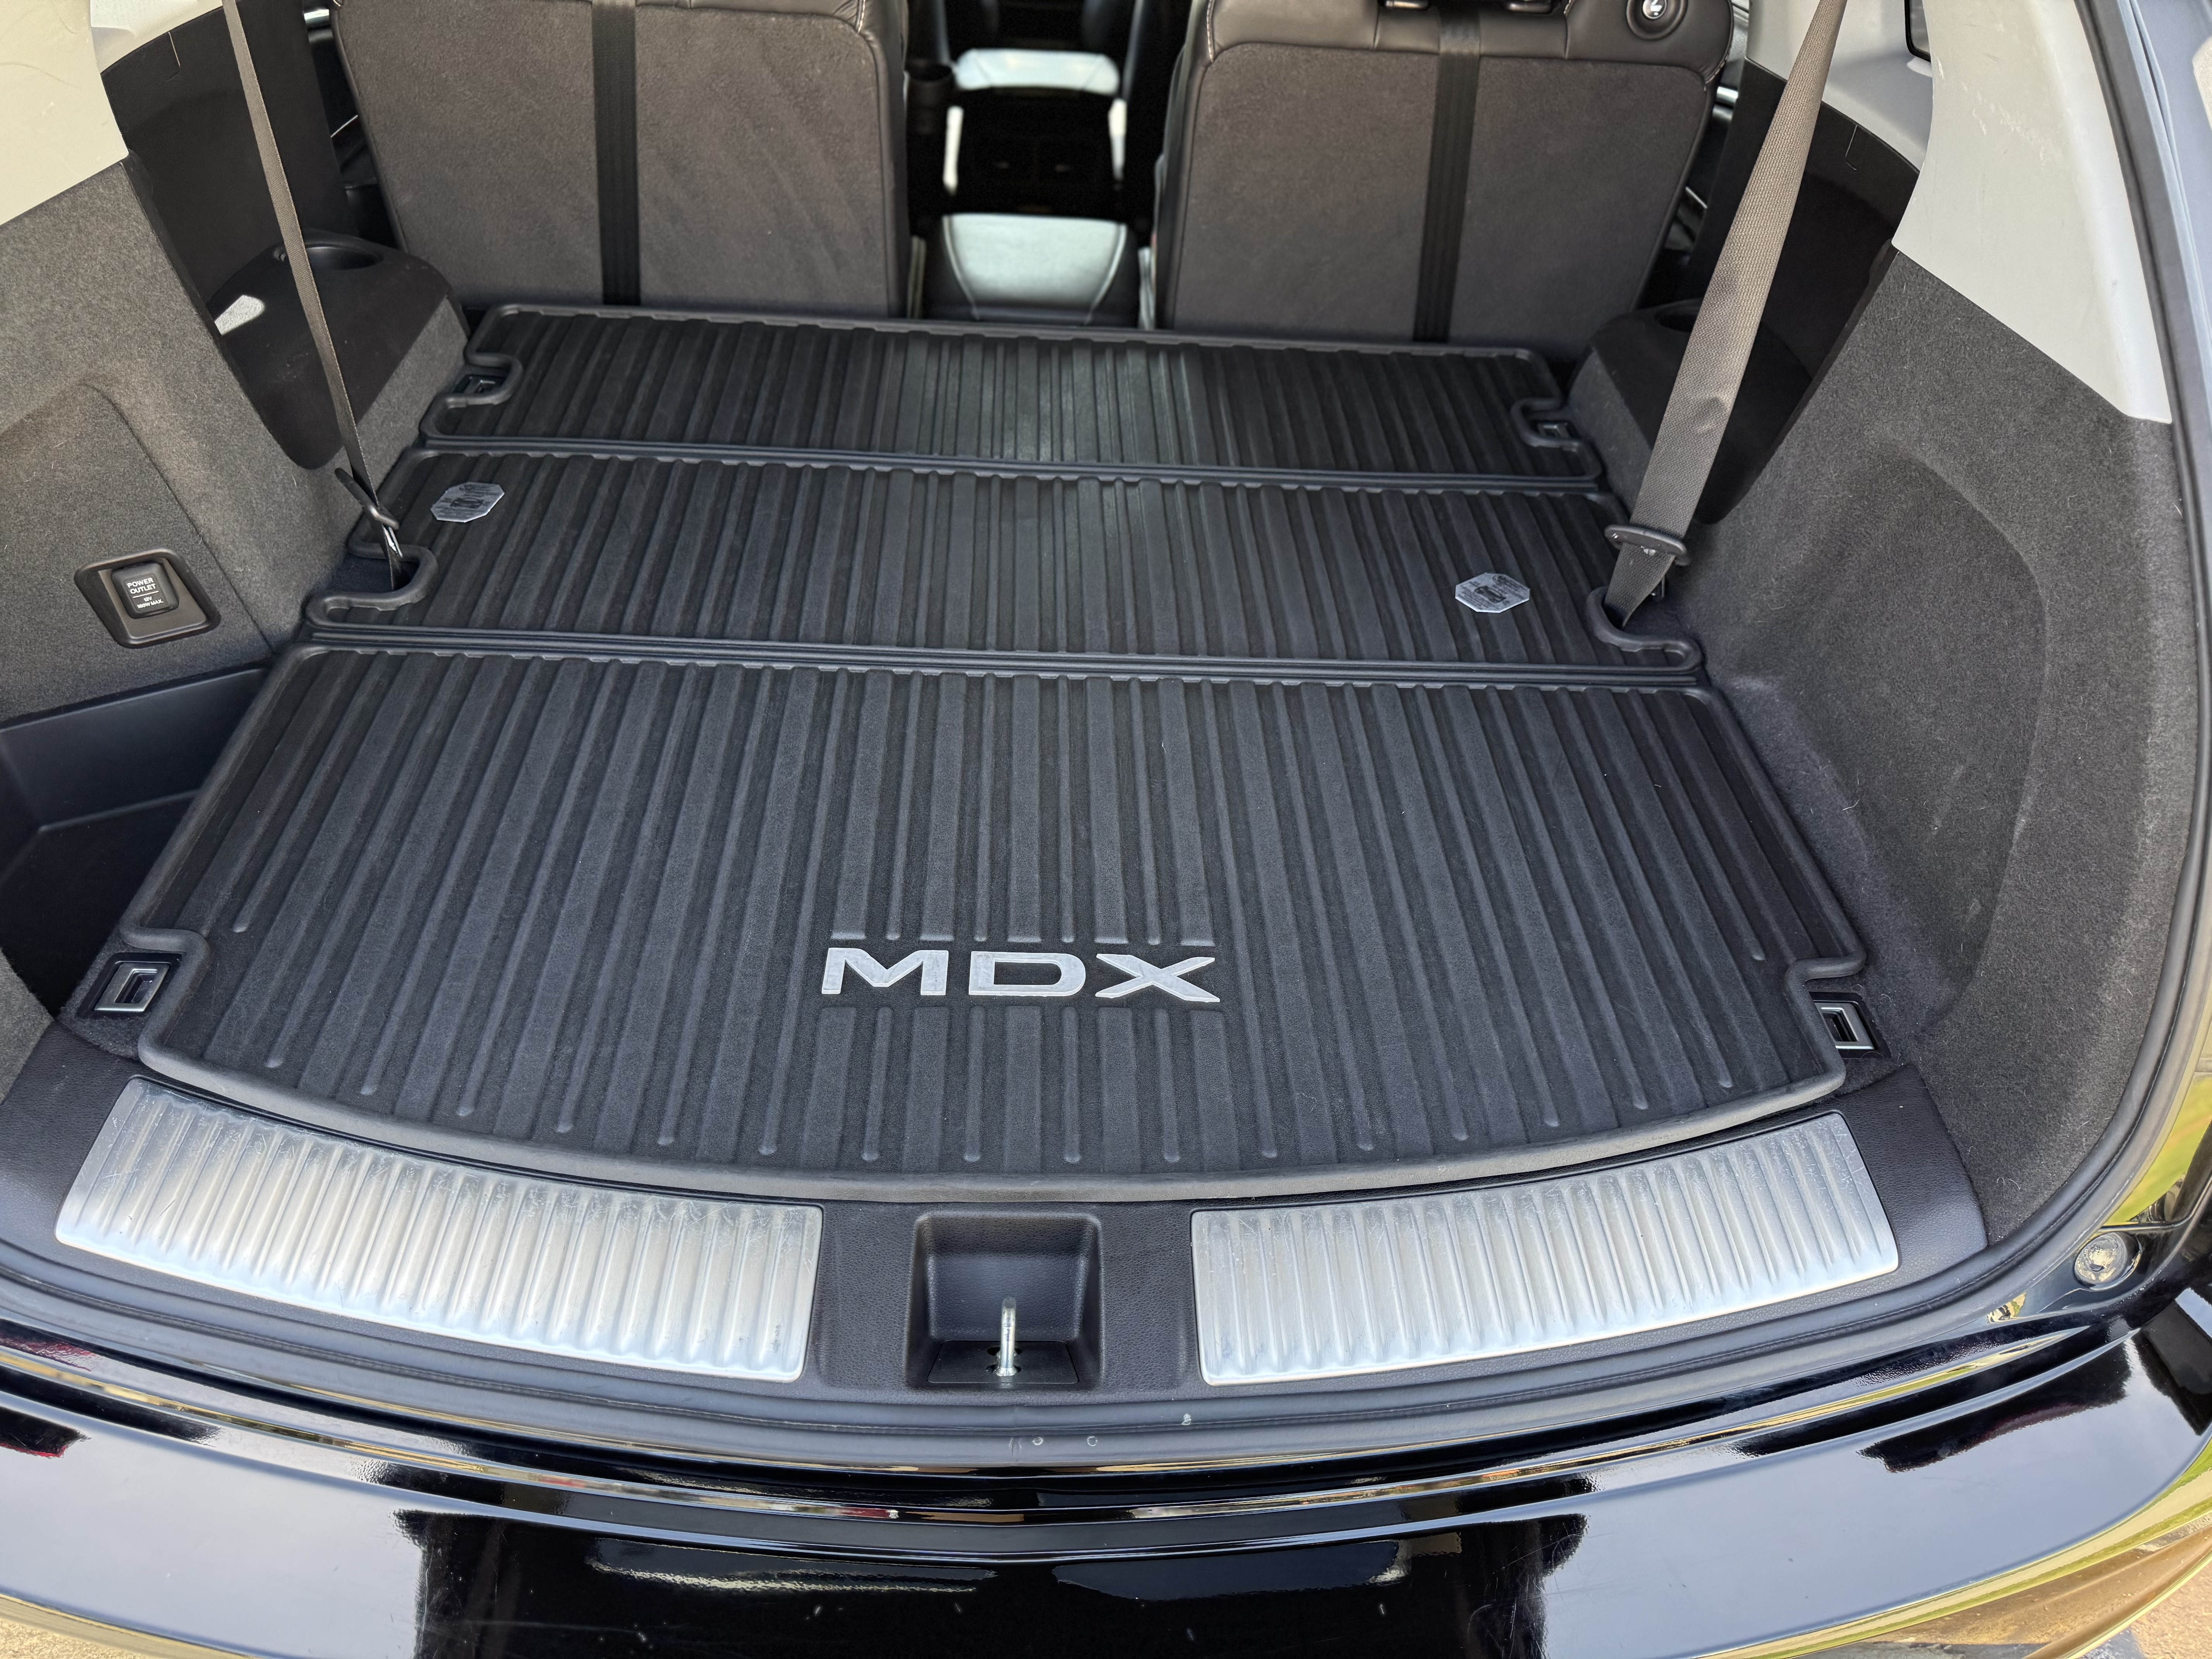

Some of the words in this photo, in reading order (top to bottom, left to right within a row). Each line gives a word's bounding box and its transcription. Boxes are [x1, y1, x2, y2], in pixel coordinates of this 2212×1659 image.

[127, 577, 154, 588] POWER
[130, 583, 155, 594] OUTLET
[822, 947, 1220, 1002] MDX
